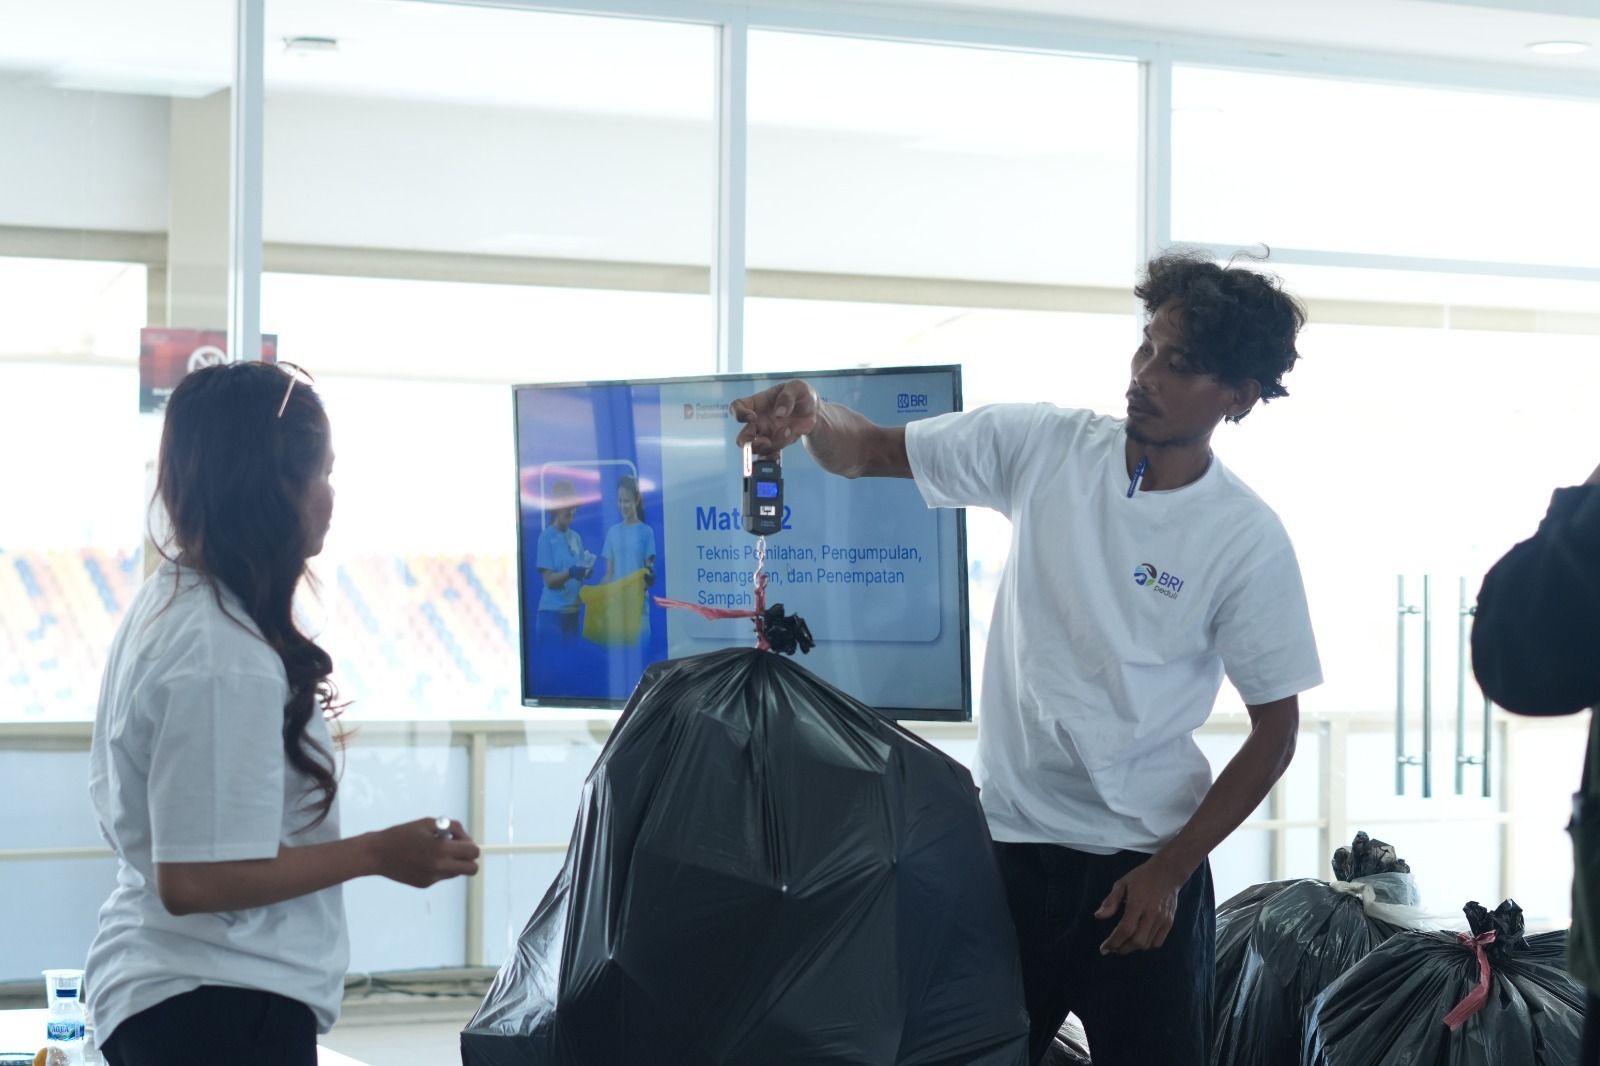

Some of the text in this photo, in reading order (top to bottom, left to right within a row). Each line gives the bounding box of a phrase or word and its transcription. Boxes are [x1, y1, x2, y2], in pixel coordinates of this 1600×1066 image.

[911, 394, 928, 407] BRI
[696, 505, 792, 531] Mat 2
[697, 545, 740, 560] Teknis
[822, 544, 922, 564] Pengumpulan,
[787, 567, 812, 583] dan
[817, 568, 904, 587] Penempatan
[1158, 571, 1184, 593] BRI
[698, 590, 751, 608] Sampah
[1153, 585, 1178, 600] peduli
